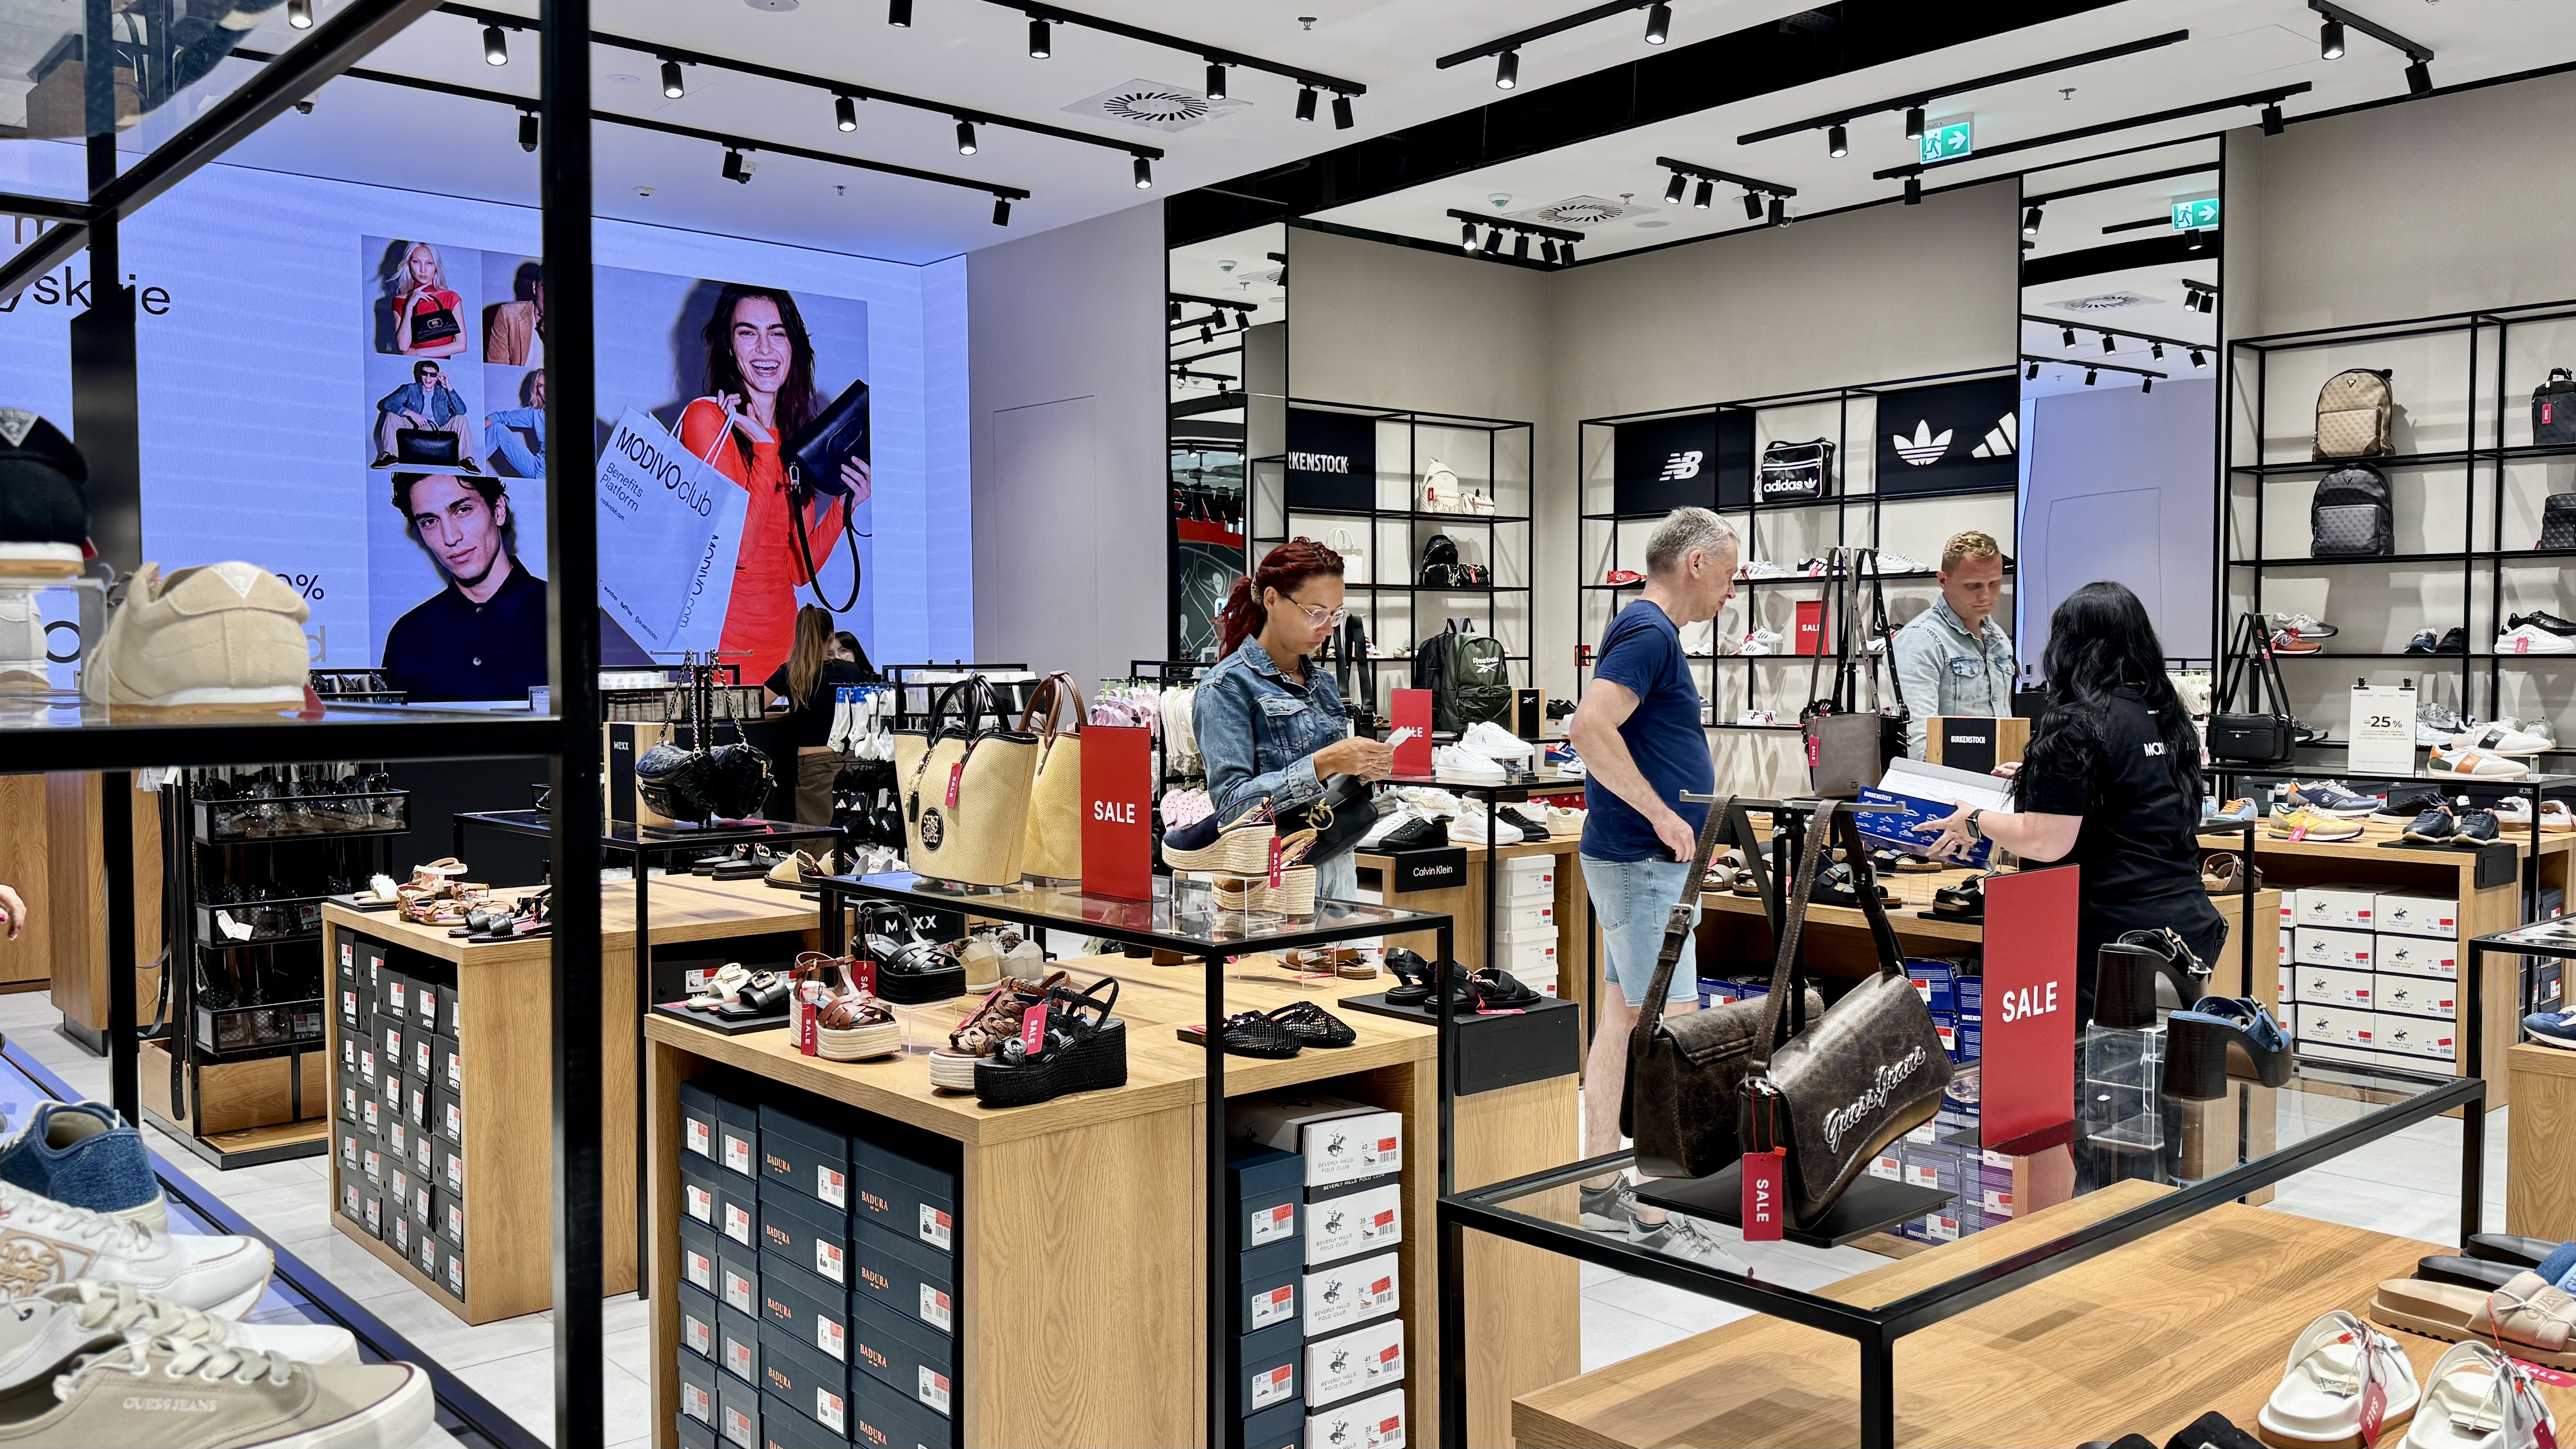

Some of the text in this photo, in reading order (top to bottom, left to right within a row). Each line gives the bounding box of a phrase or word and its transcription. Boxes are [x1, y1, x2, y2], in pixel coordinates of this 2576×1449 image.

[607, 462, 643, 497] Benefits
[1763, 477, 1803, 493] adidas
[600, 474, 639, 512] Platform
[1801, 624, 1820, 632] SAL
[1472, 656, 1500, 665] Reebok
[1950, 735, 1986, 745] BIRKENSTOCK
[948, 775, 957, 799] SALE
[1094, 800, 1136, 824] SALE
[1413, 865, 1453, 877] Calvin Klein
[2002, 981, 2057, 1022] SALE
[1027, 1019, 1038, 1045] SALE
[767, 1153, 791, 1173] BADURA
[1318, 1160, 1339, 1168] BEVERLY
[1323, 1182, 1343, 1191] BEVERLY
[861, 1191, 888, 1211] BADURA
[1756, 1178, 1770, 1223] SALE
[766, 1224, 790, 1245] BADURA
[1316, 1237, 1338, 1247] BEVERLY
[1320, 1243, 1334, 1251] POLO
[861, 1267, 889, 1289] BADURA
[767, 1297, 792, 1319] BADURA
[1314, 1308, 1335, 1316] BEVERLY
[1318, 1310, 1347, 1321] POLO CLUB
[860, 1343, 887, 1368] BADURA
[768, 1366, 791, 1390] BADURA
[1320, 1372, 1357, 1387] BEVERLY HILLS
[2518, 1364, 2561, 1381] SALE
[1325, 1383, 1339, 1392] POLO
[2366, 1396, 2378, 1430] SALE
[860, 1420, 887, 1445] BADURA
